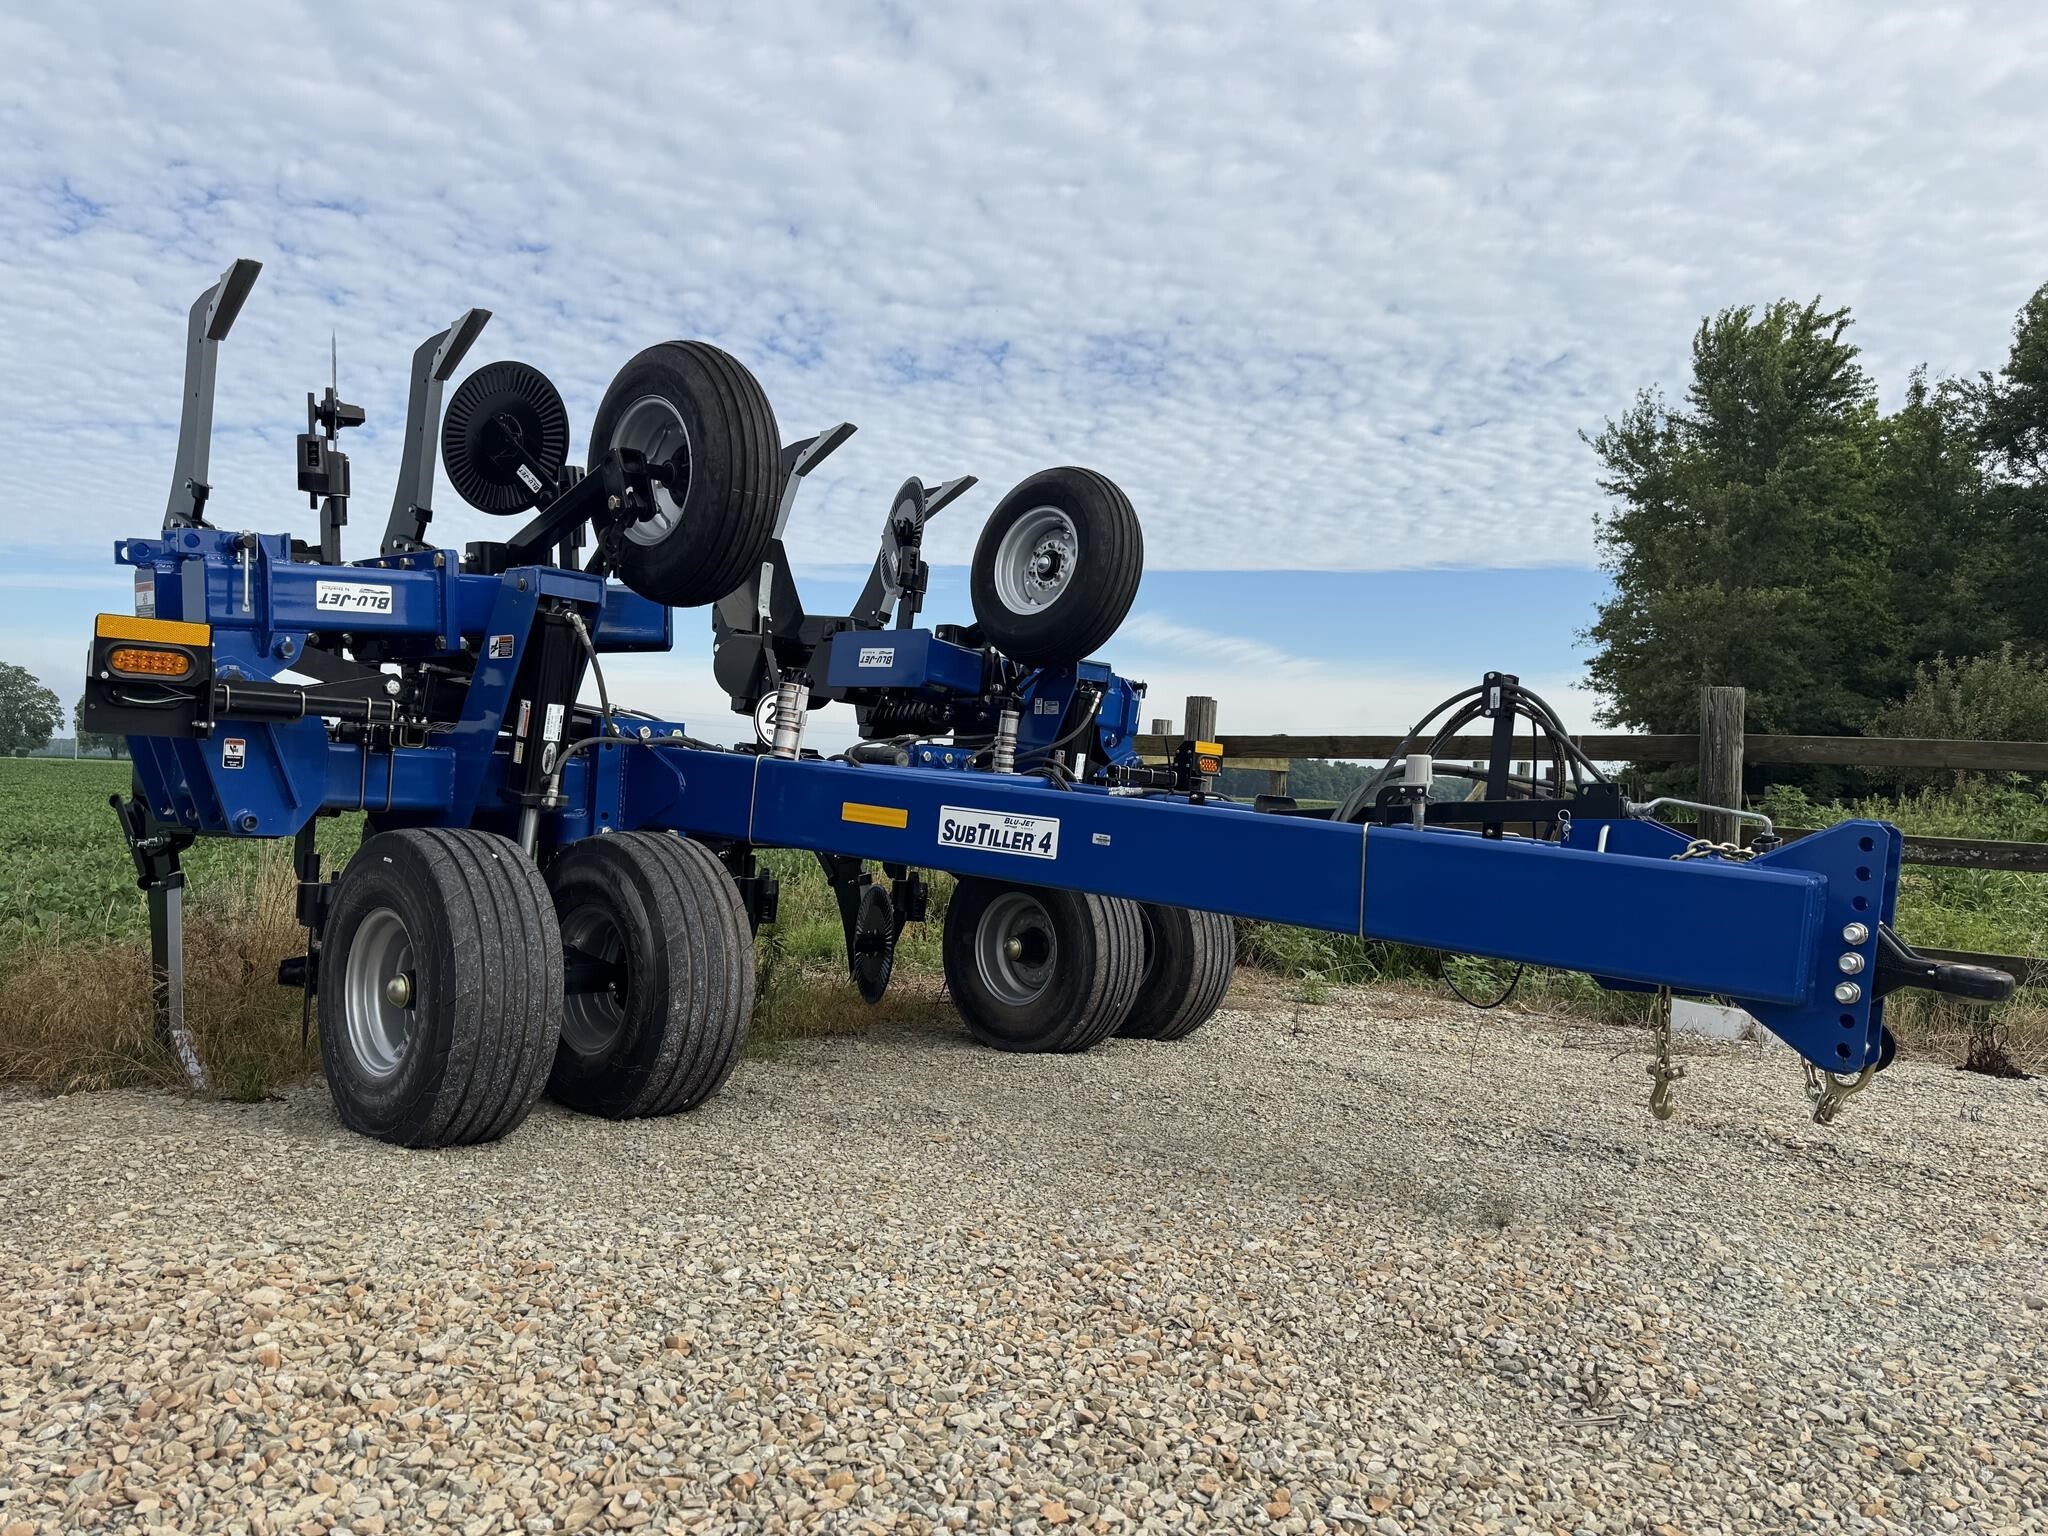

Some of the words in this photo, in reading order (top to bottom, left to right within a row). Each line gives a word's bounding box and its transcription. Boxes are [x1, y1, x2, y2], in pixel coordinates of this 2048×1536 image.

[318, 593, 391, 610] BLU-JET
[860, 655, 893, 665] BLU-JET
[1004, 817, 1036, 828] BLU-JET
[1038, 831, 1053, 854] 4
